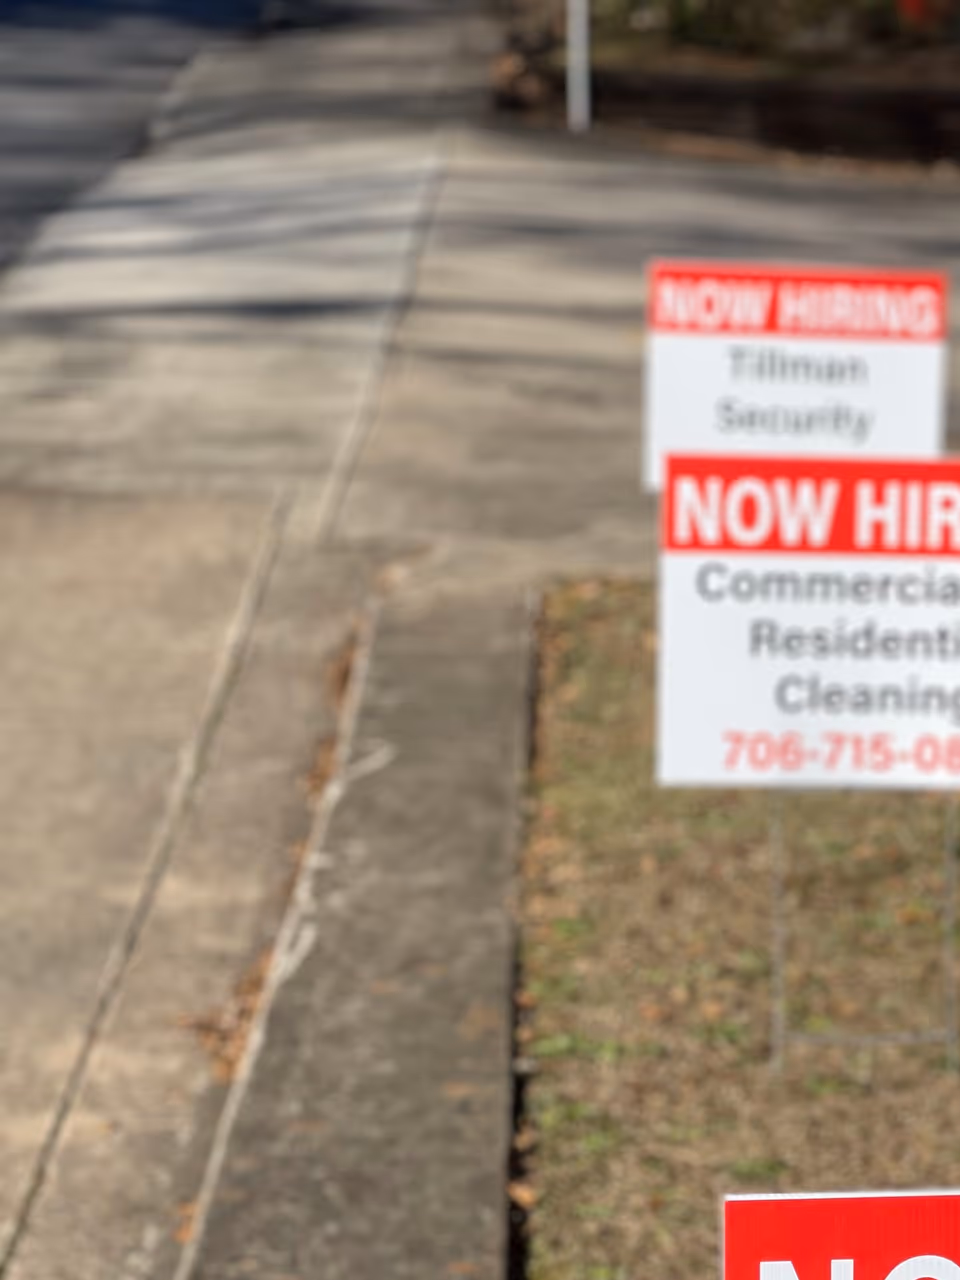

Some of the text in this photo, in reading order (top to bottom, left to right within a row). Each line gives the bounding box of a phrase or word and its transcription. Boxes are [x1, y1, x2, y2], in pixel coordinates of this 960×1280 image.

[657, 277, 939, 335] NOW HIRING
[727, 345, 869, 386] Tillman
[715, 396, 875, 446] Security
[674, 476, 839, 547] NOW
